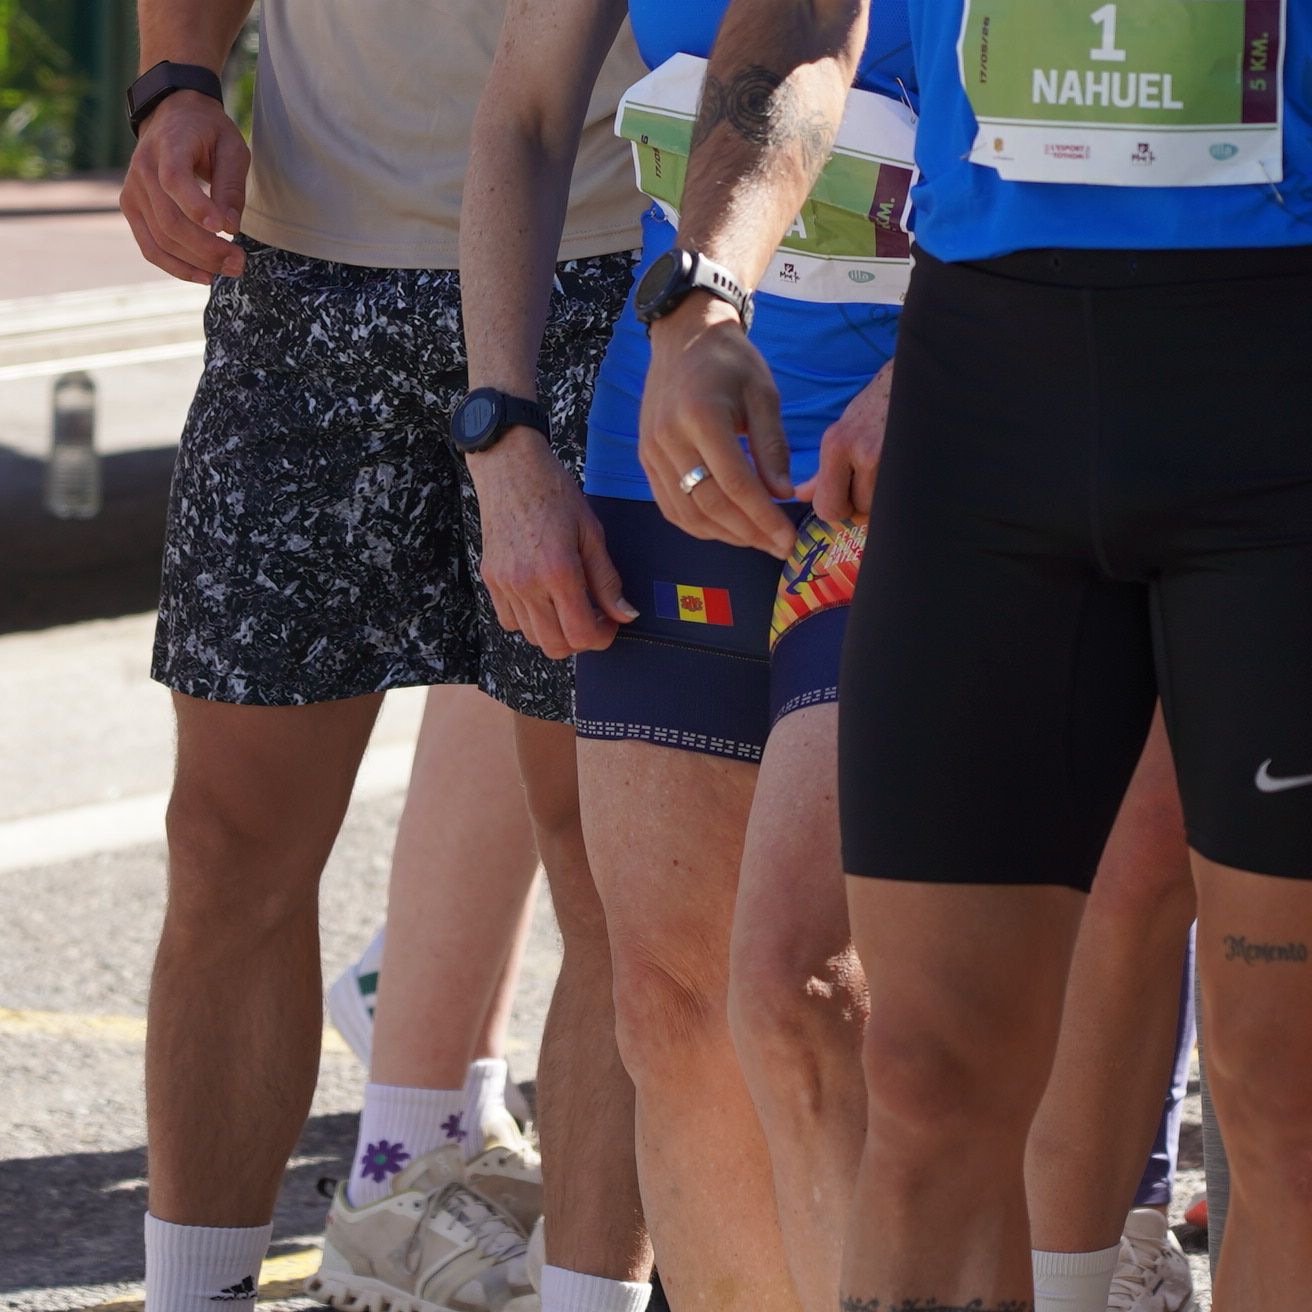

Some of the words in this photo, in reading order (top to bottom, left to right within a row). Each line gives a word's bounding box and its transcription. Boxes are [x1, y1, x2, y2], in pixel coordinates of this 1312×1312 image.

[1089, 3, 1126, 62] 1
[1250, 32, 1269, 72] KM.
[1031, 68, 1184, 110] NAHUEL
[1249, 78, 1267, 91] 5
